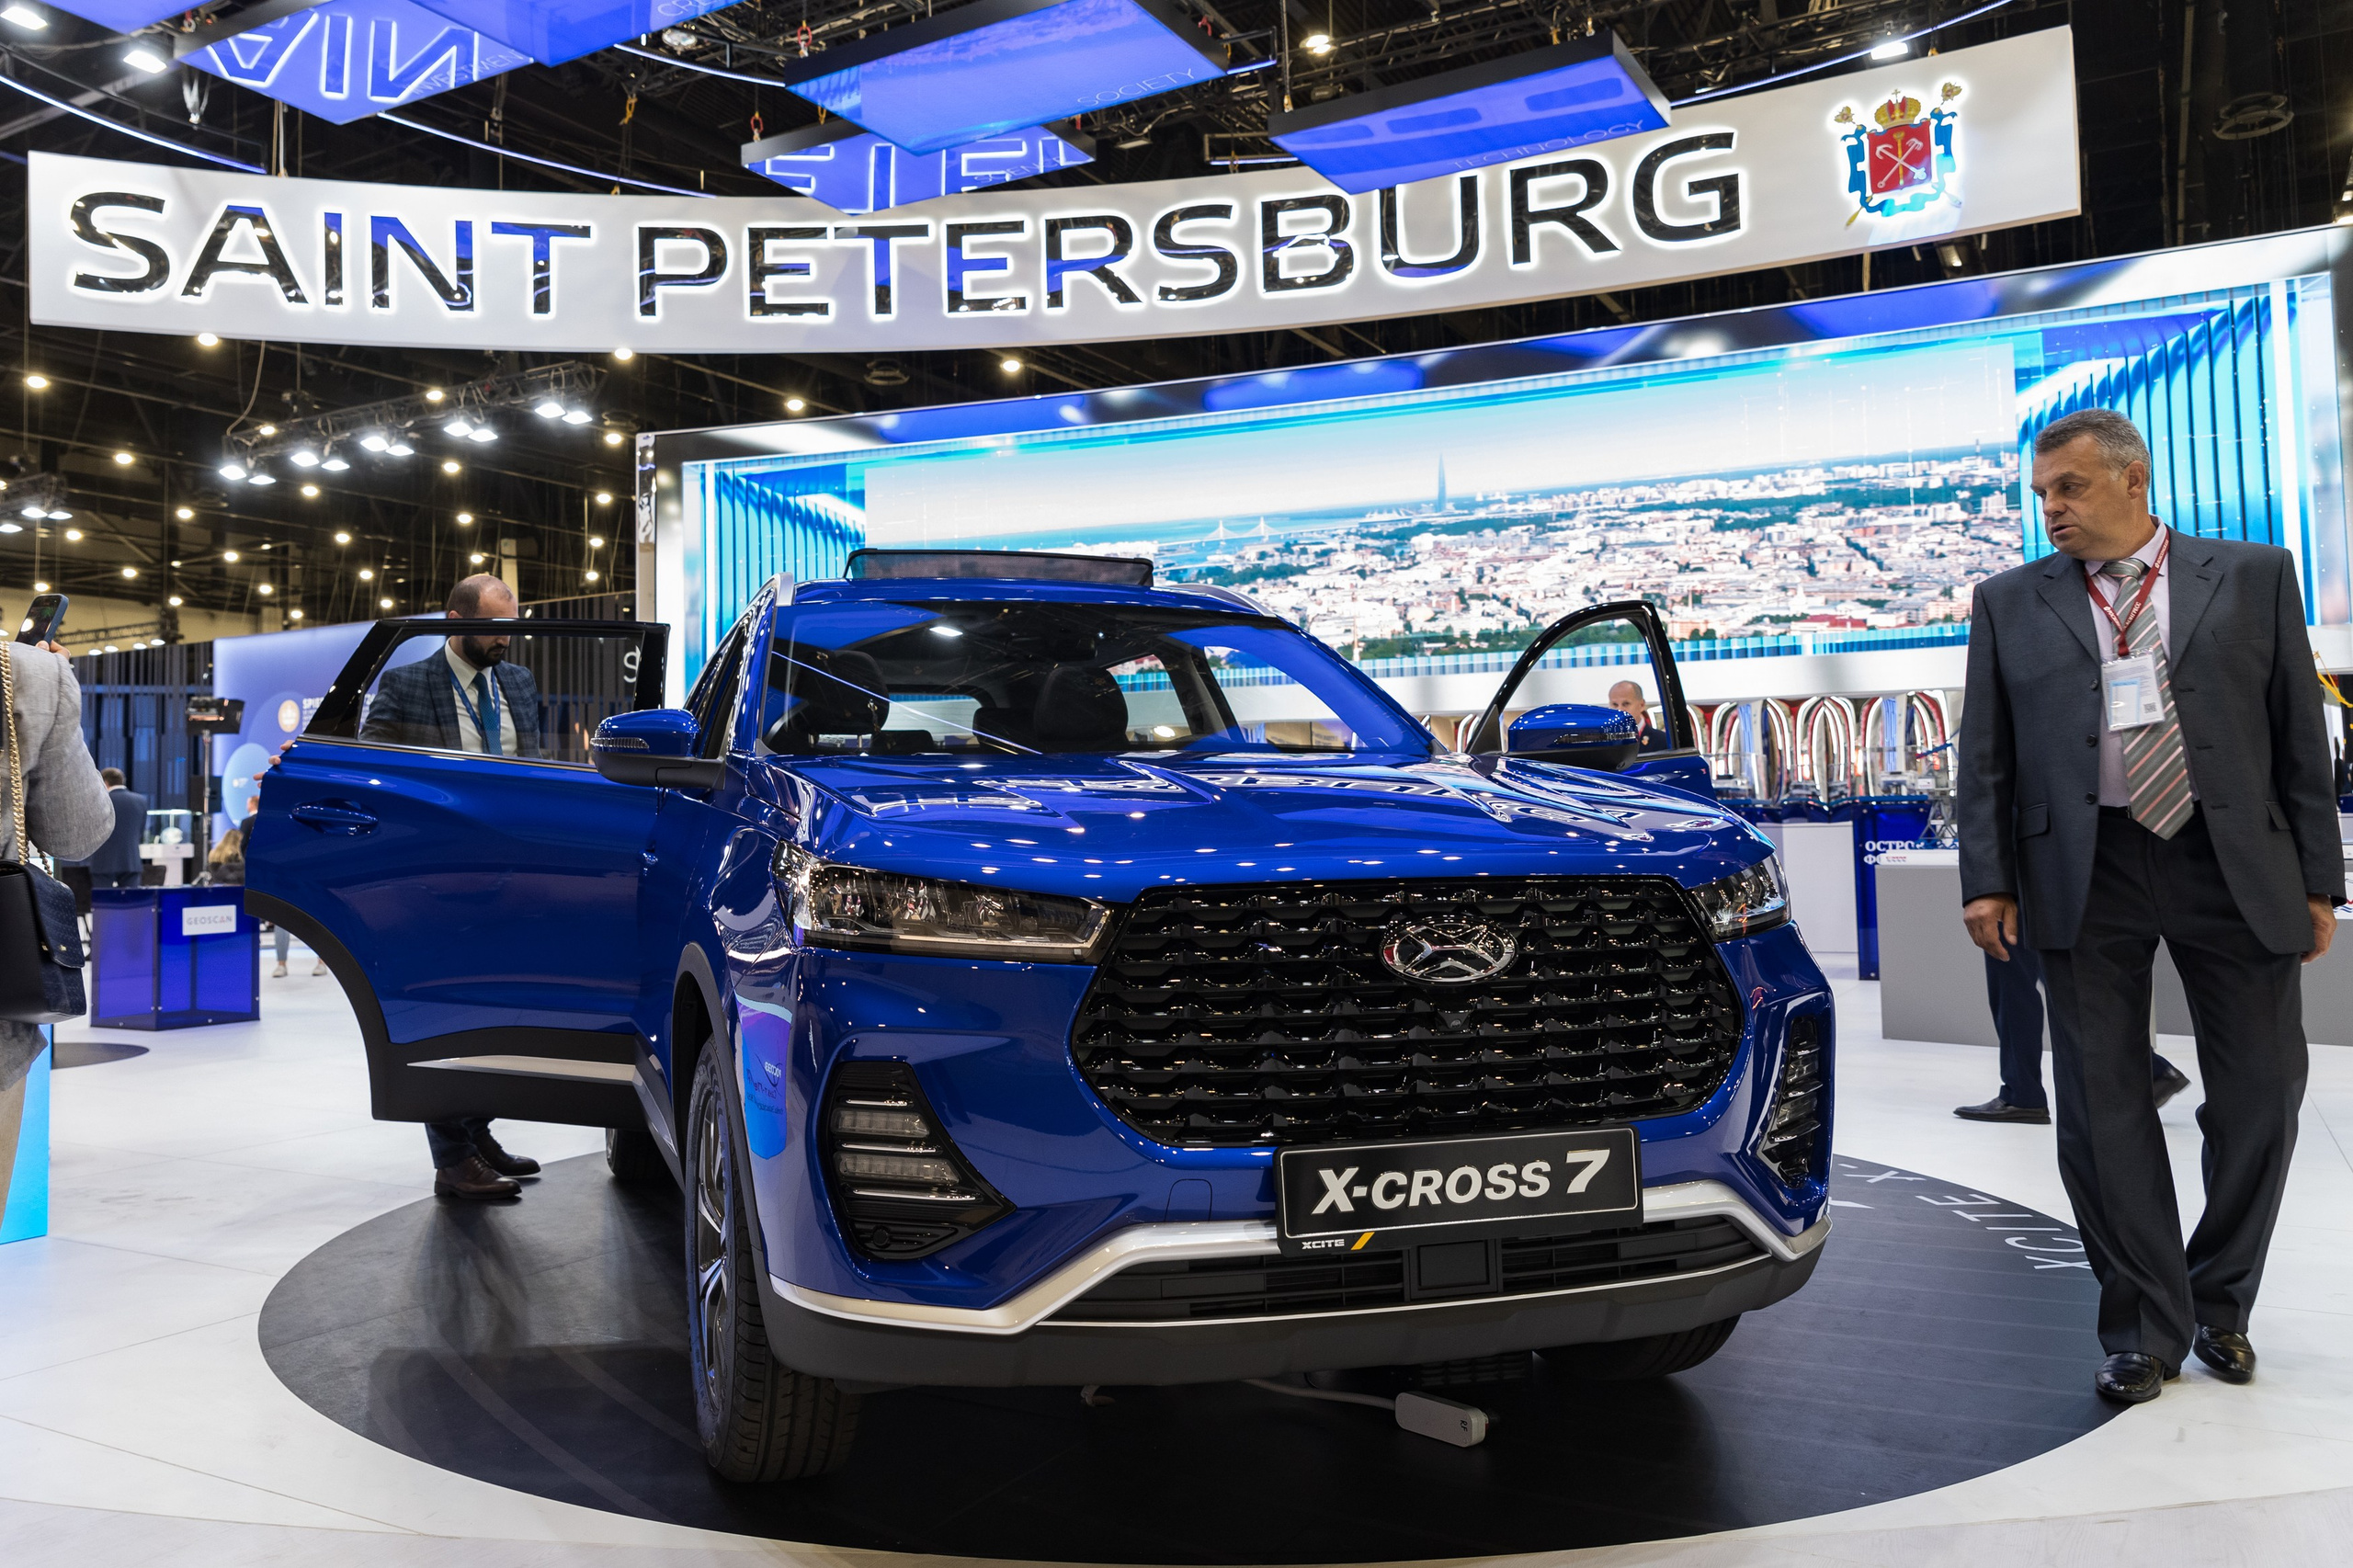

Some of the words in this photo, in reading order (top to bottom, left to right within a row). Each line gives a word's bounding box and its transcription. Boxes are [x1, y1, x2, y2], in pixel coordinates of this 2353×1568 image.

[412, 50, 525, 96] INVESTMEN
[1077, 68, 1194, 108] SOCIETY
[1447, 119, 1643, 170] TECHNOLOGY
[70, 191, 592, 316] SAINT
[638, 131, 1743, 319] PETERSBURG
[1864, 840, 1923, 852] ОСТРО
[186, 915, 233, 926] GEOSCAN
[1311, 1159, 1552, 1215] X-CROSS
[1566, 1148, 1610, 1194] 7
[1302, 1238, 1345, 1249] XCITE
